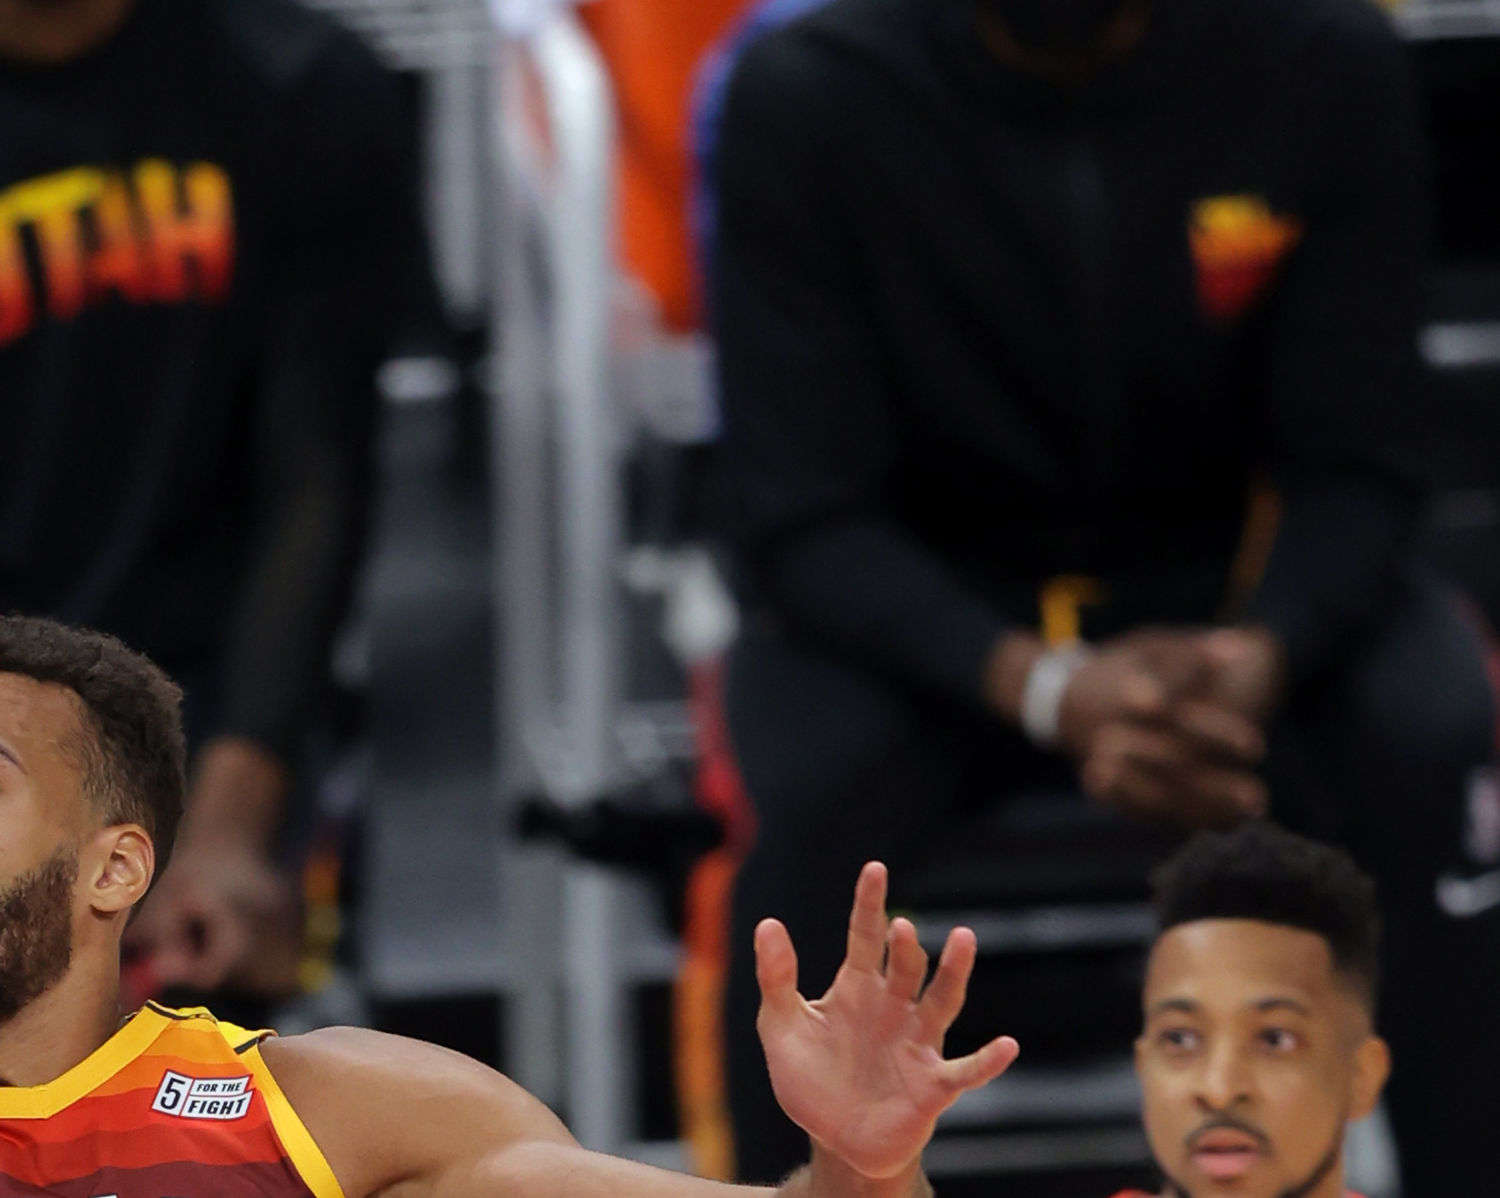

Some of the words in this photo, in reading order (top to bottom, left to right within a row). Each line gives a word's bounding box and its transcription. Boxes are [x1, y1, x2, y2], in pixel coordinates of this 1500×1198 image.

[160, 1077, 186, 1110] 5
[196, 1083, 217, 1093] FOR
[221, 1082, 243, 1093] THE
[187, 1097, 247, 1116] FIGHT
